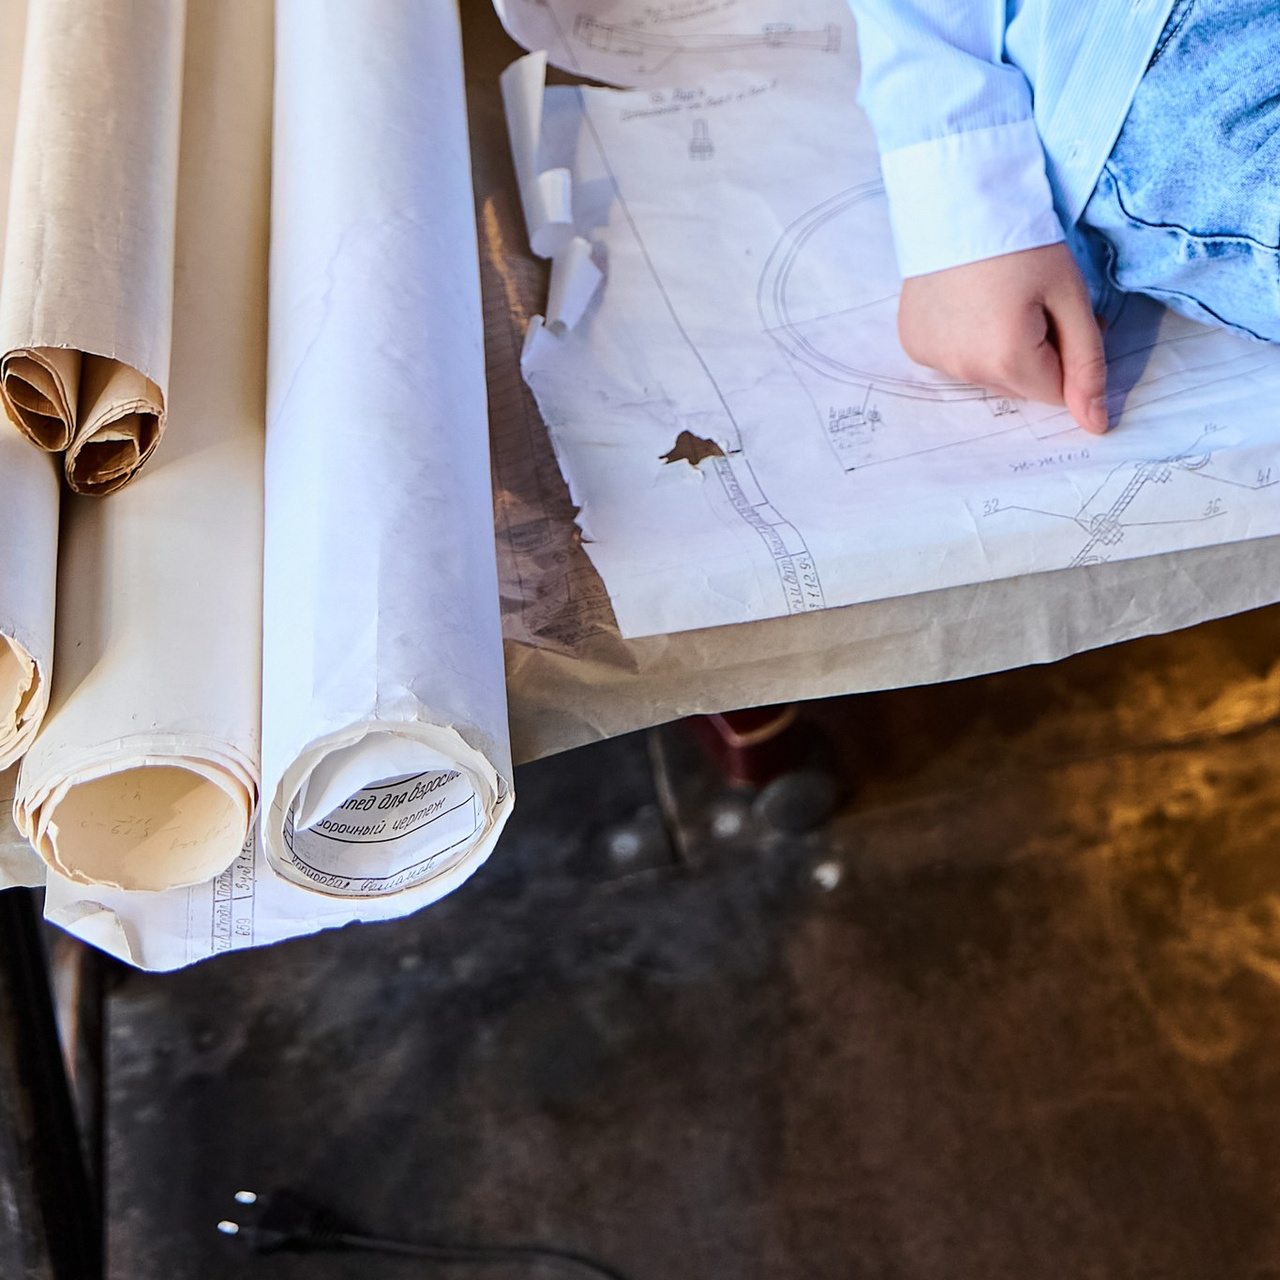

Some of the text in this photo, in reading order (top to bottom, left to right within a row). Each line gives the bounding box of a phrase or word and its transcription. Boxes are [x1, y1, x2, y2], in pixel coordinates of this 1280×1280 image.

[983, 498, 999, 514] 32
[378, 792, 408, 810] для
[392, 797, 446, 831] чертеж
